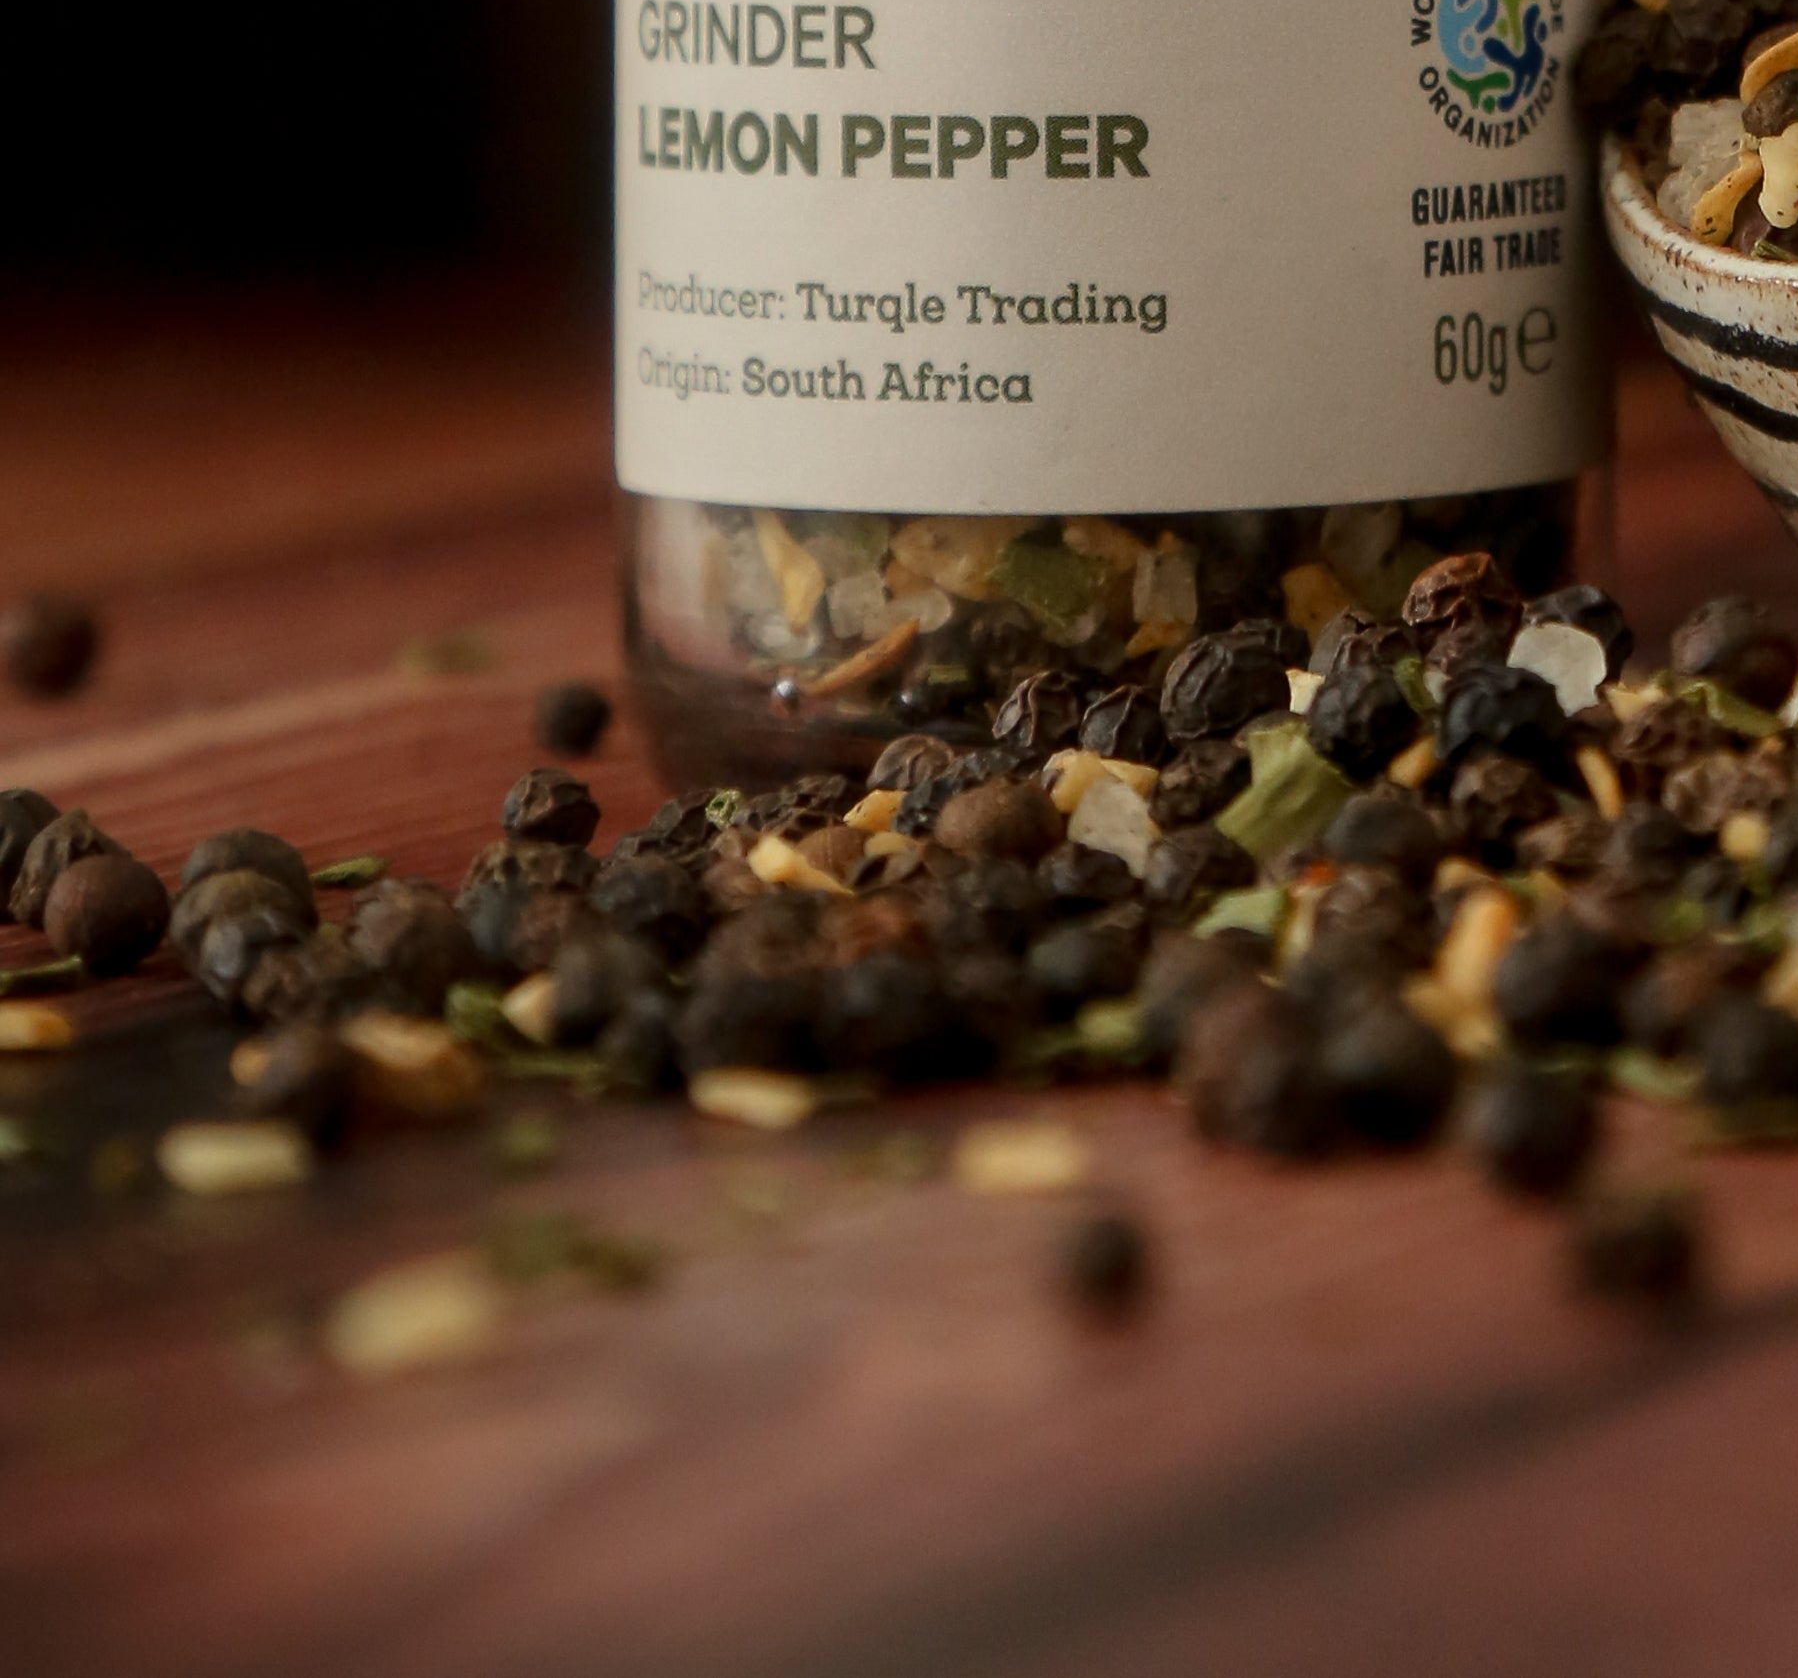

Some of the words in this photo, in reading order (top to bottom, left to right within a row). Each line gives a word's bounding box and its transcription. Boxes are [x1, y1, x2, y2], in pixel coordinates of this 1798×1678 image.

[1418, 56, 1560, 148] ORGANIZATION
[638, 105, 819, 178] LEMON
[840, 114, 1151, 180] PEPPER
[1411, 174, 1567, 227] GUARANTEED
[1423, 236, 1484, 278] FAIR
[1492, 226, 1562, 272] TRADE
[638, 270, 786, 322] Producer:
[794, 282, 946, 334] Turqle
[956, 283, 1168, 334] Trading
[638, 346, 732, 400] Origin:
[740, 357, 867, 401] South
[875, 361, 1034, 405] Africa
